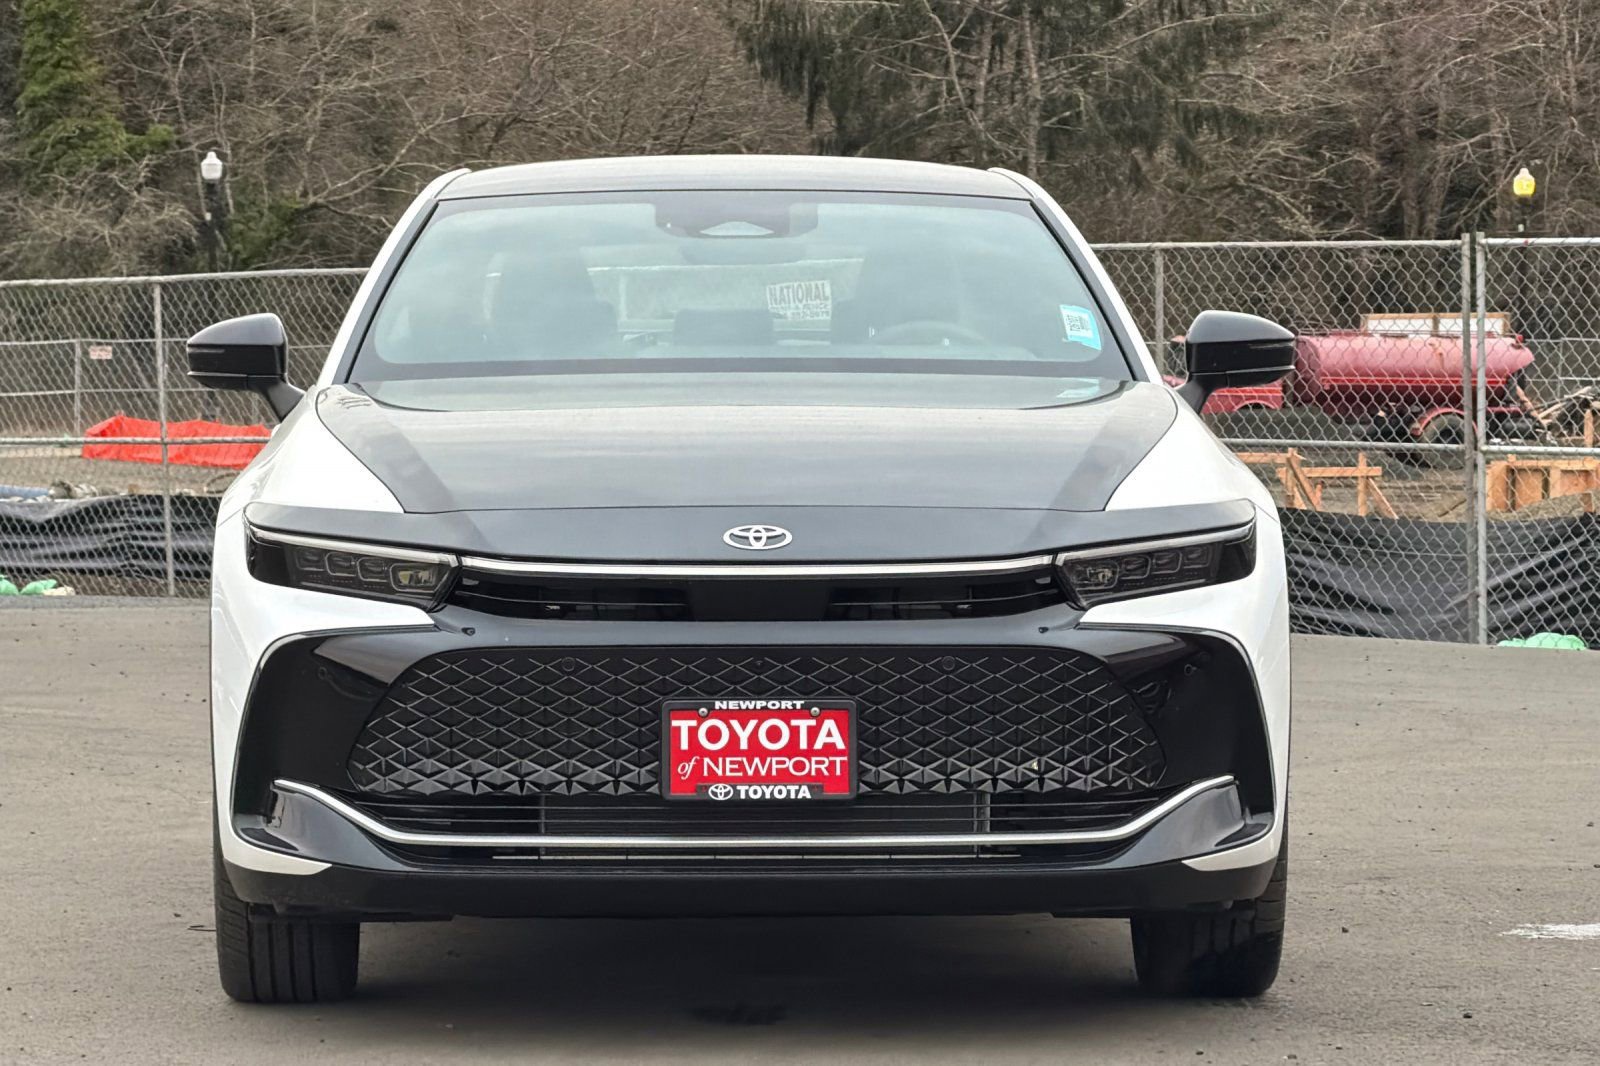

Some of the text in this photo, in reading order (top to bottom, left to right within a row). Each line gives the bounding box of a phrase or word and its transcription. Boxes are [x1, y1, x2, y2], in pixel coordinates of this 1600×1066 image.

[768, 282, 830, 305] NATIONAL
[714, 700, 805, 710] NEWPORT
[671, 718, 846, 751] TOYOTA
[677, 756, 848, 780] of NEWPORT
[736, 785, 812, 799] TOYOTA
